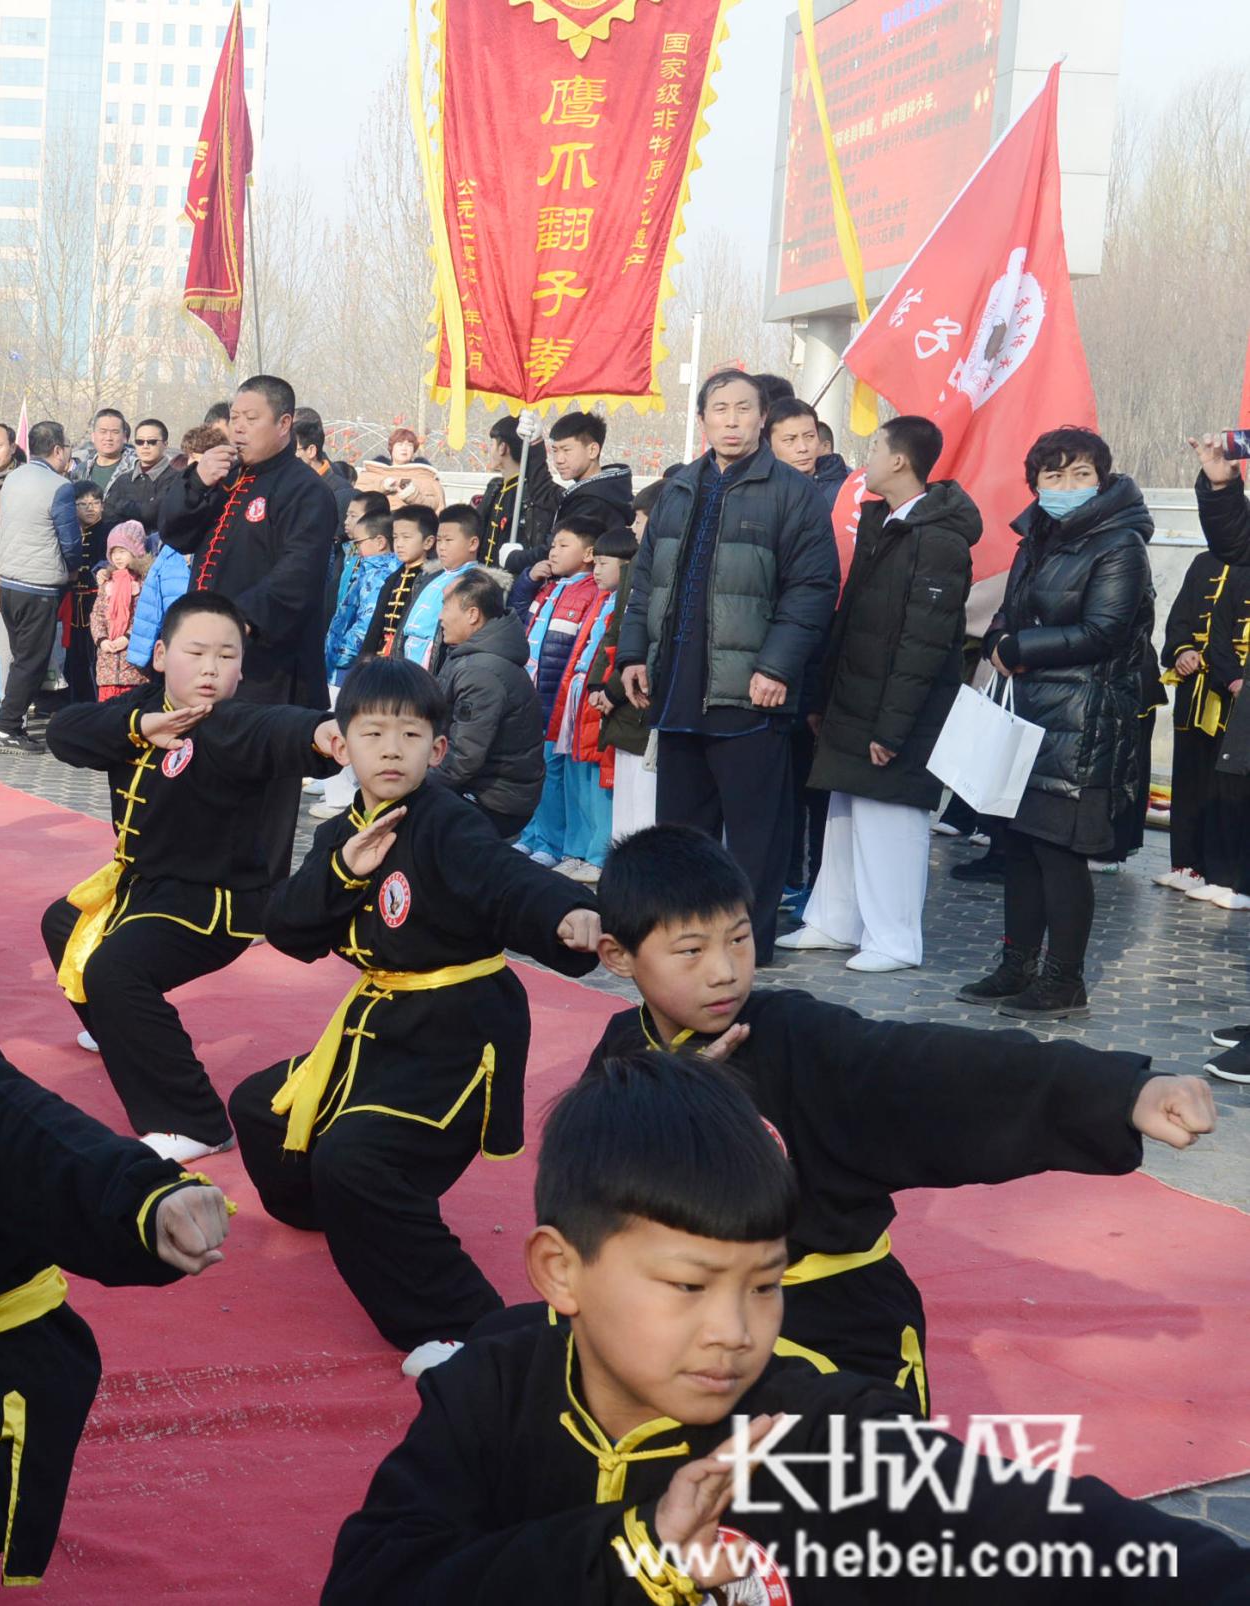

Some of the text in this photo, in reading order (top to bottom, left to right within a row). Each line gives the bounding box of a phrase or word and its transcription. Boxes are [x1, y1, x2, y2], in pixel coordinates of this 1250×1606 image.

[524, 76, 607, 387] 鹰爪翻子拳
